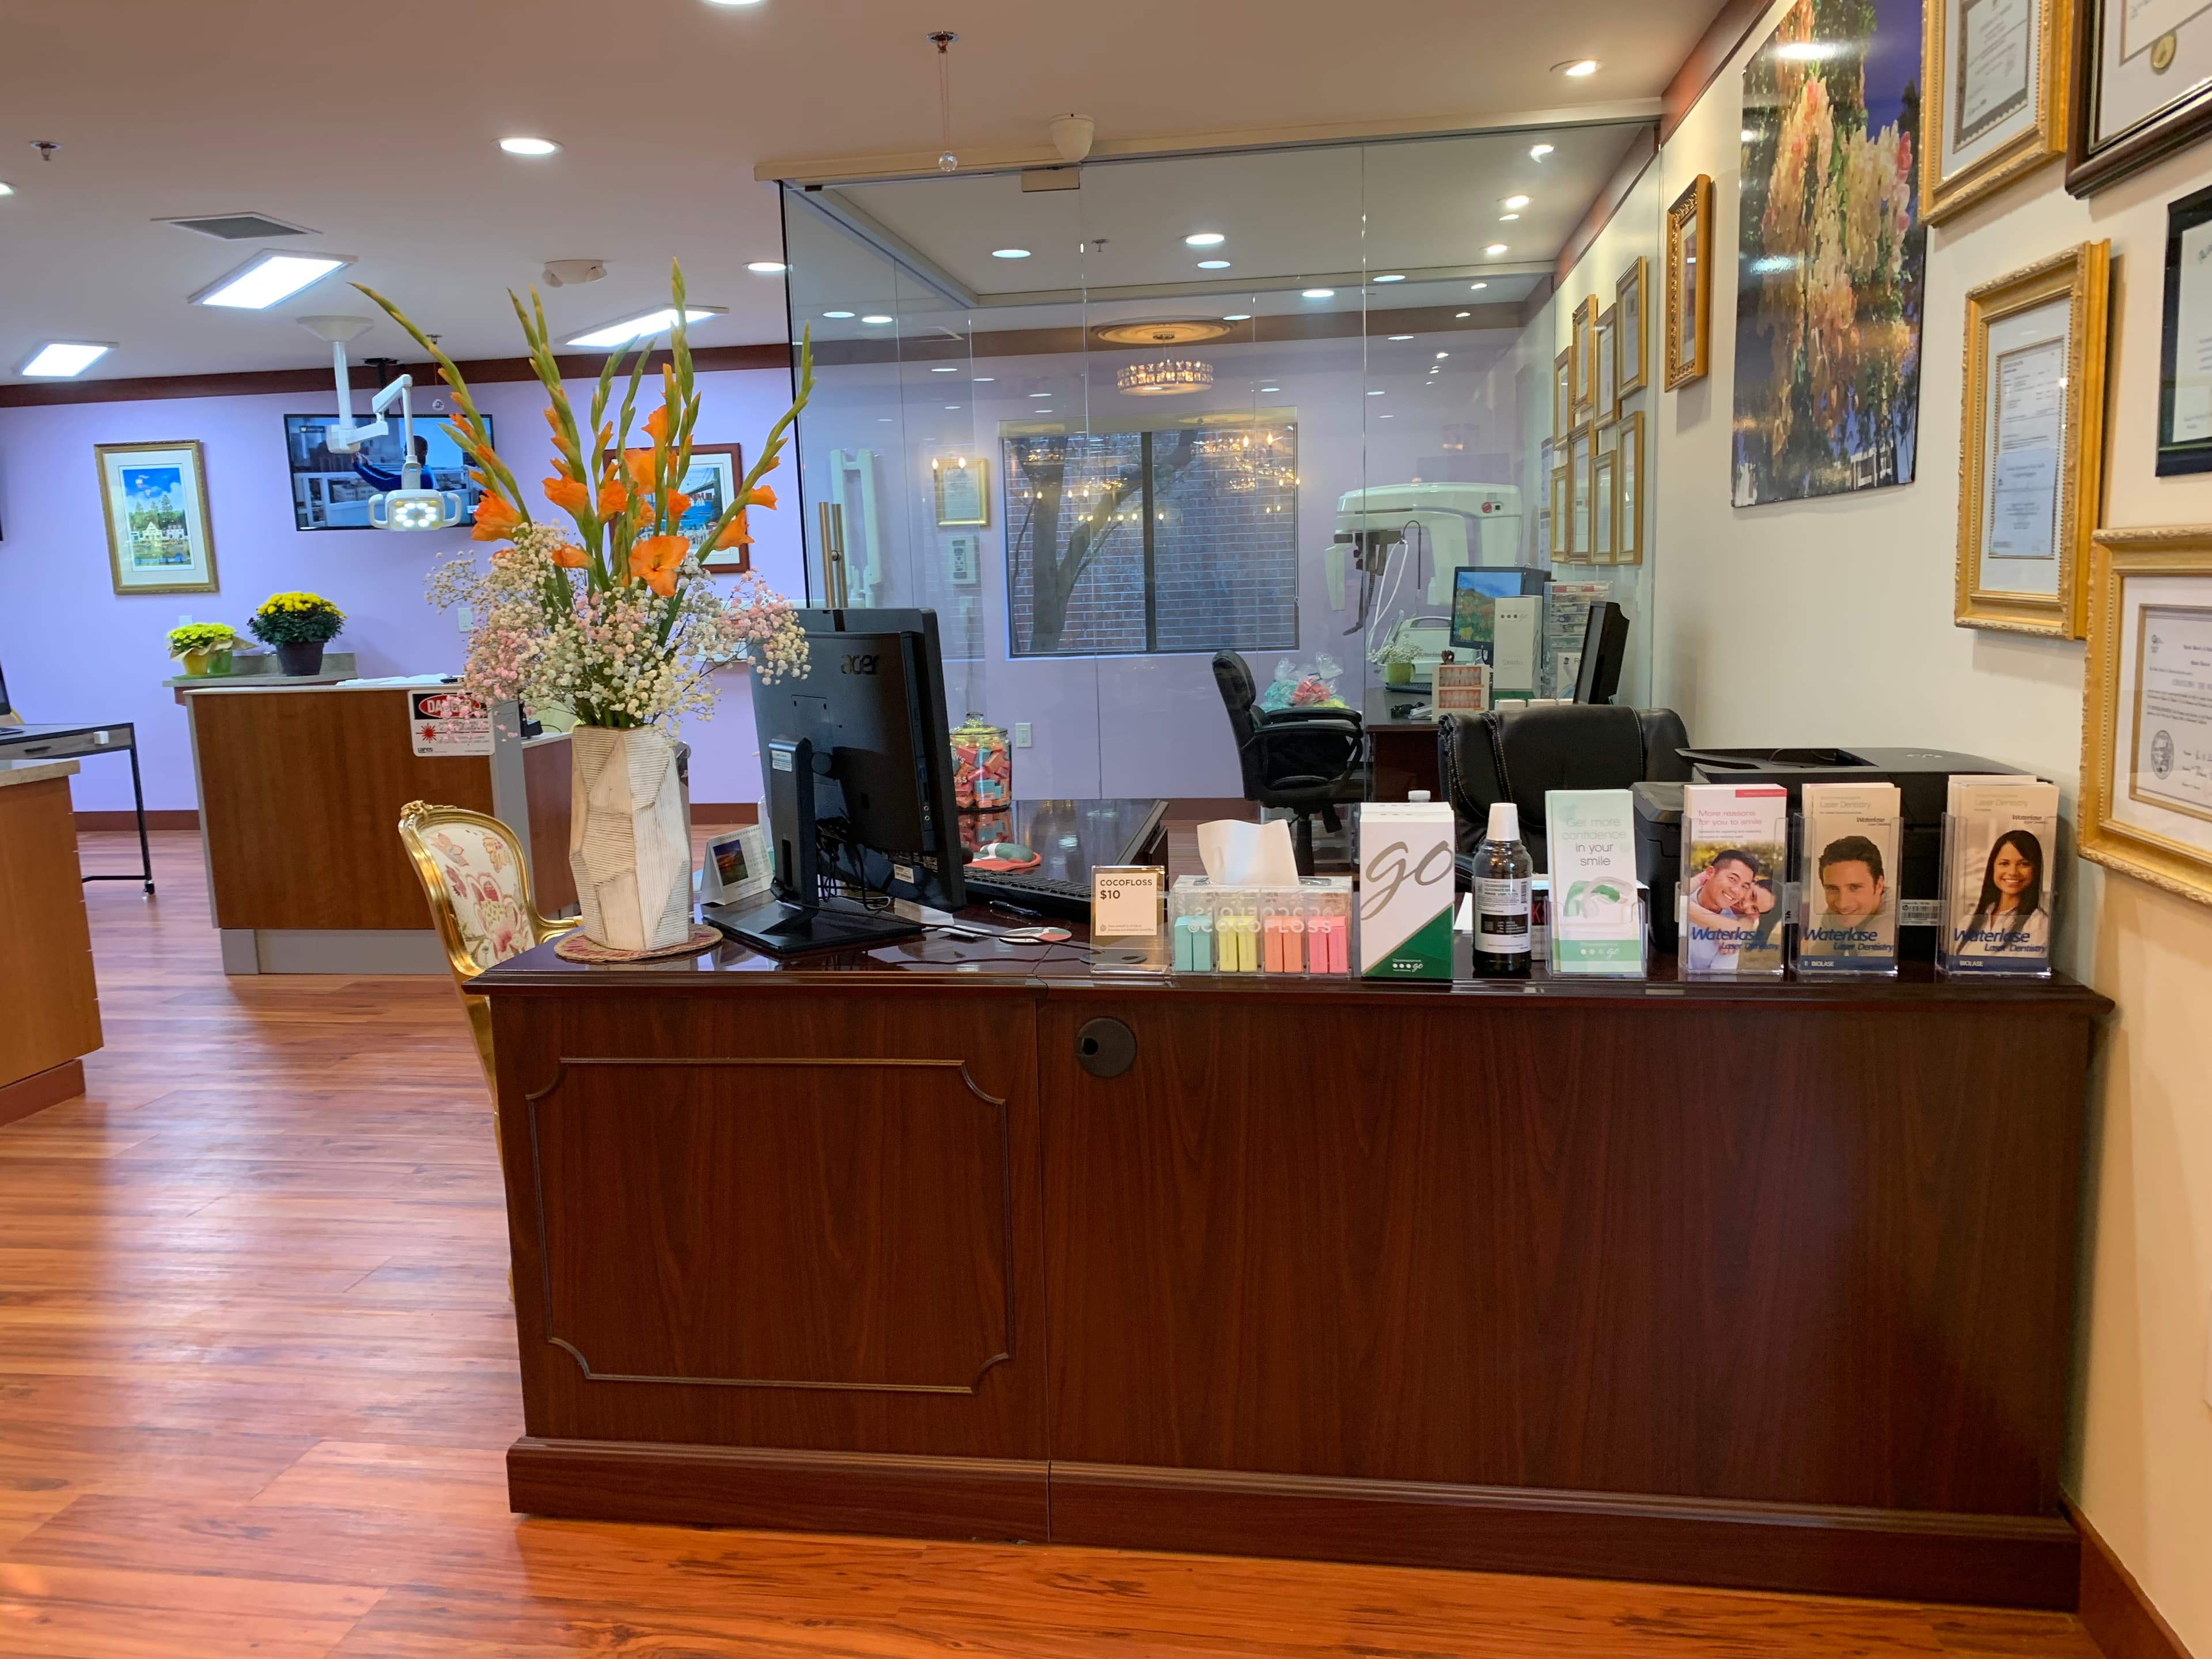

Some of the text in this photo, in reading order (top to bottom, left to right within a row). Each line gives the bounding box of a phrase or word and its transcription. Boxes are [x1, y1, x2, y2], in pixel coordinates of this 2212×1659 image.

[841, 654, 880, 675] acer
[1566, 818, 1621, 827] Get more
[1562, 830, 1626, 840] confidence
[1575, 843, 1614, 854] in your
[1580, 856, 1611, 866] smile
[1361, 840, 1454, 921] go
[1100, 889, 1120, 900] $10
[1692, 927, 1764, 941] Waterlase
[1804, 927, 1878, 941] Waterlase
[1954, 928, 2030, 942] Waterlase
[1858, 943, 1893, 952] Dentistry
[2010, 945, 2046, 953] Dentistry
